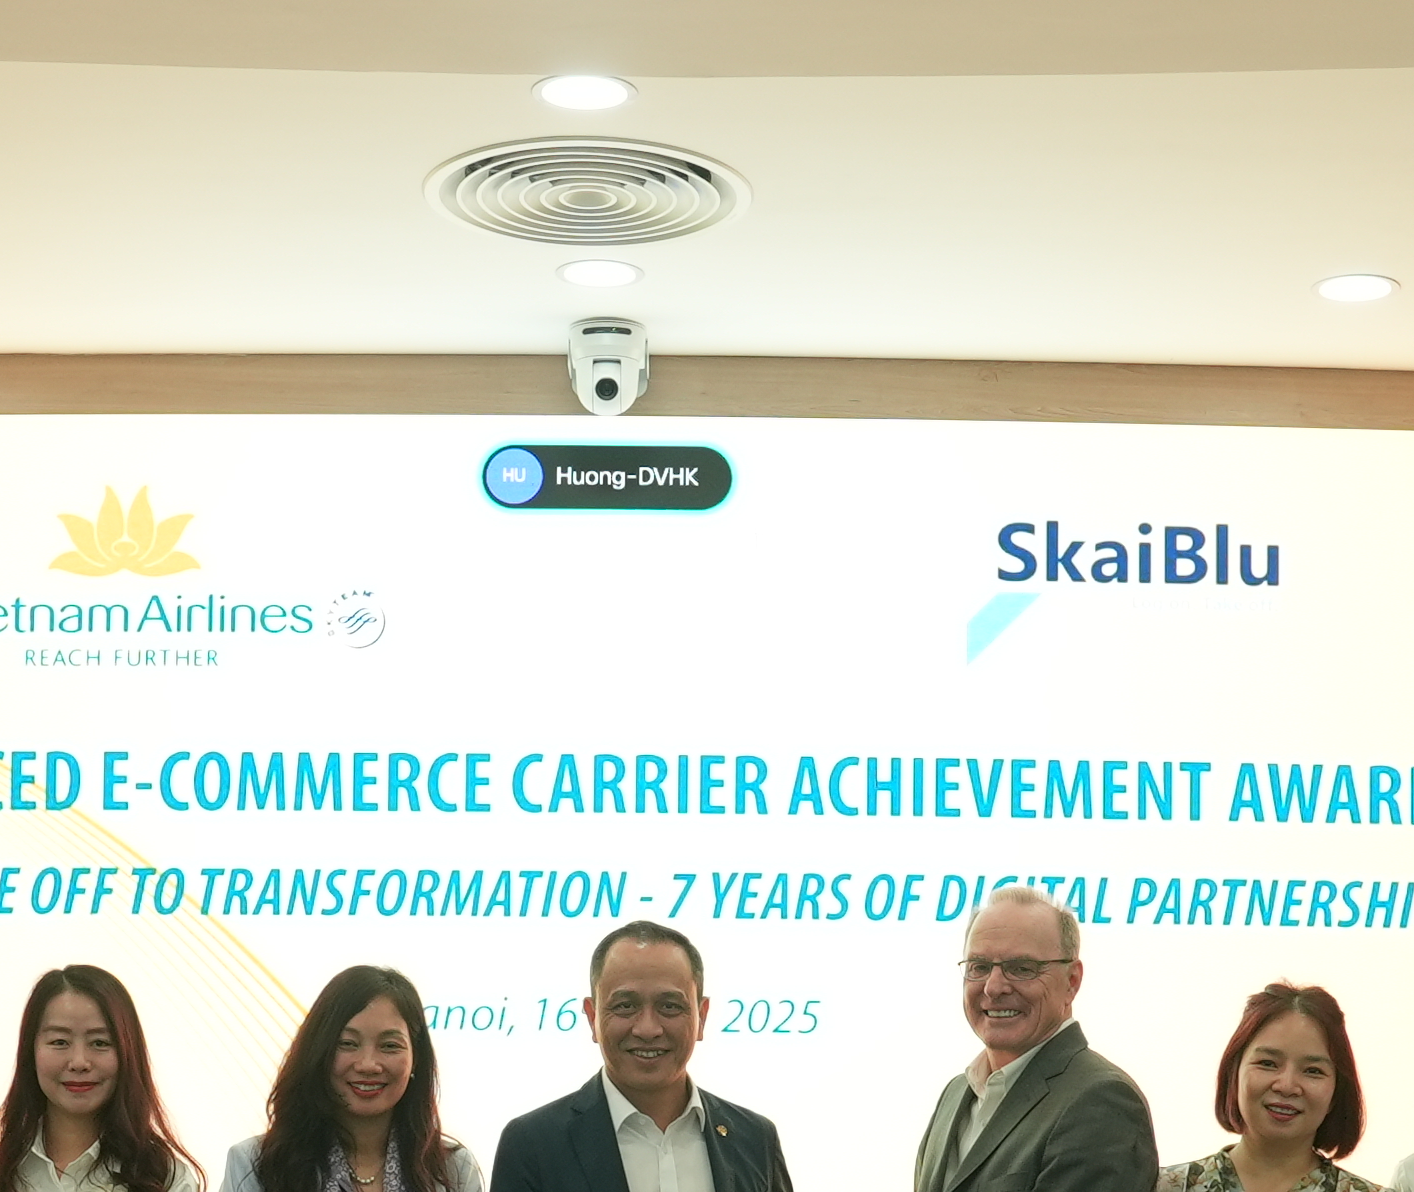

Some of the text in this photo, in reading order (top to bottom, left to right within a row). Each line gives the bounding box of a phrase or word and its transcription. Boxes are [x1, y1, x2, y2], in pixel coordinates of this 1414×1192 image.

[502, 467, 527, 483] HU
[556, 466, 700, 490] Huong-DVHK
[997, 520, 1279, 587] SkaiBlu
[136, 593, 314, 634] Airlines
[25, 649, 219, 668] REACH FURTHER
[102, 751, 491, 813] E-COMMERCE
[512, 753, 769, 815] CARRIER
[787, 756, 1212, 821] ACHIEVEMENT
[30, 866, 119, 915] OFF
[131, 867, 185, 916] TO
[200, 868, 628, 918] TRANSFORMATION
[668, 873, 697, 919] 7
[712, 872, 852, 921] YEARS
[864, 873, 925, 921] OF
[425, 997, 515, 1036] anoi,
[721, 999, 821, 1034] 2025
